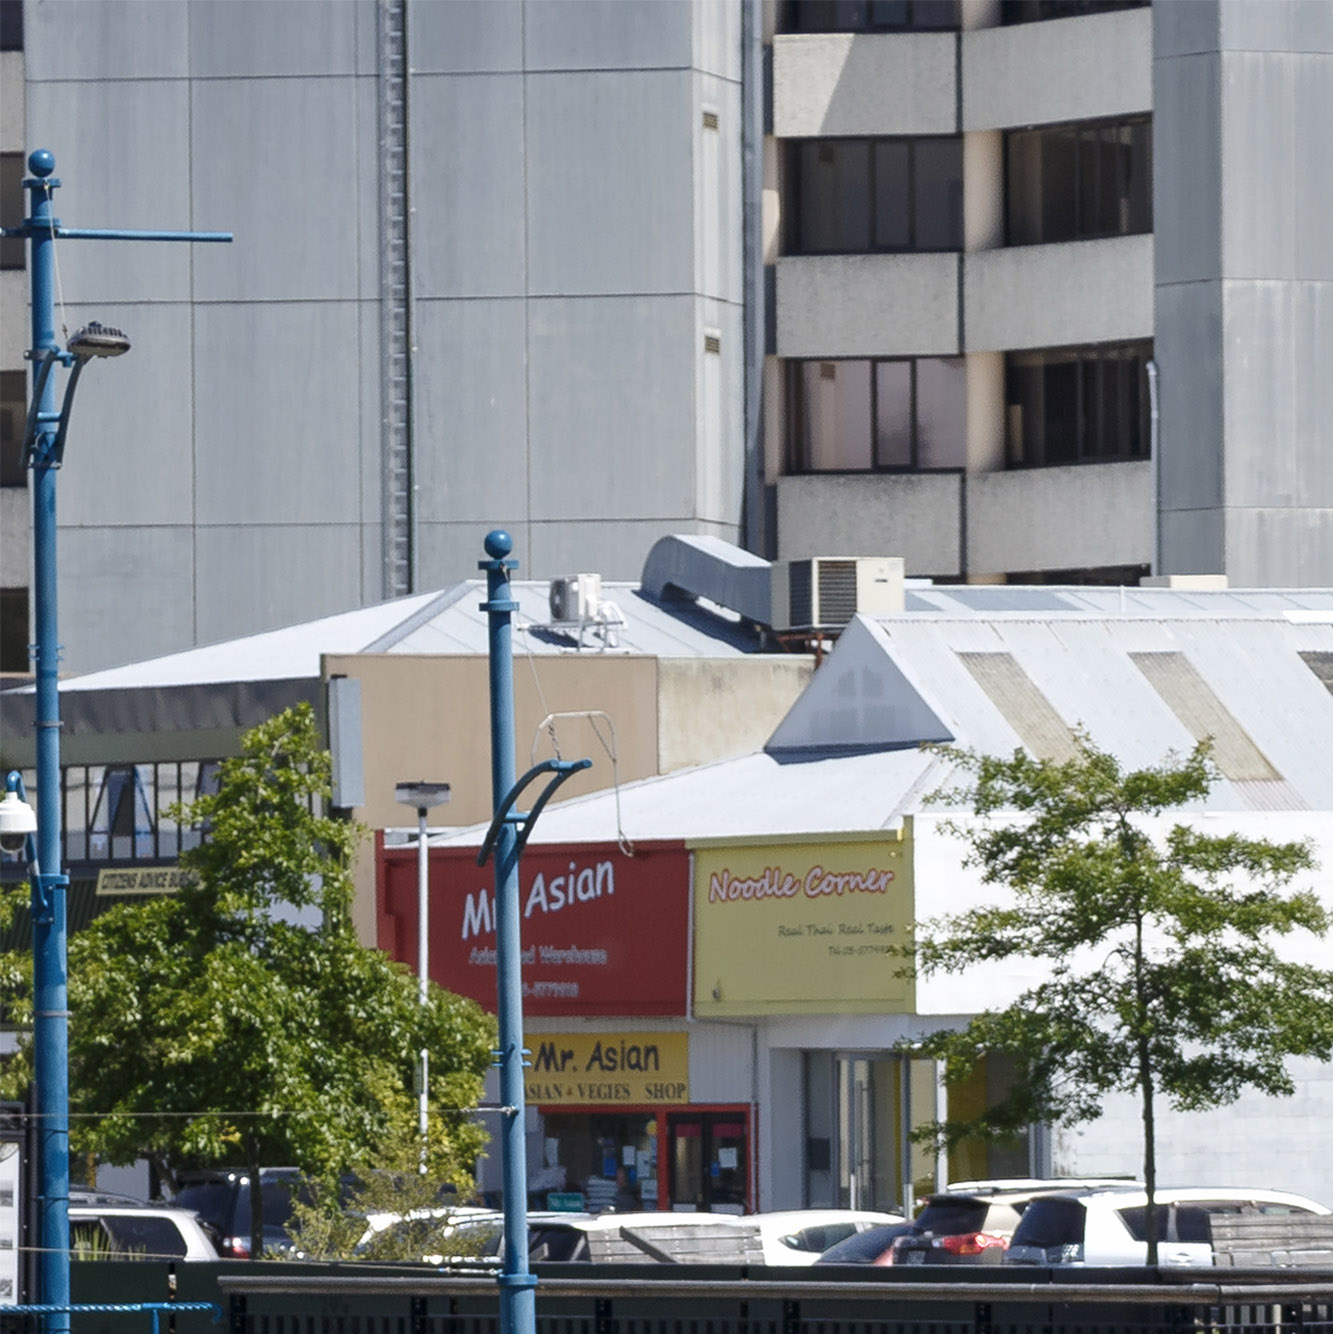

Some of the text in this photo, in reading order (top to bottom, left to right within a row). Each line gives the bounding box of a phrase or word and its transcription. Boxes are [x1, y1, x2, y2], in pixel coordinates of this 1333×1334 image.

[524, 860, 615, 919] Asian
[709, 865, 895, 904] Noodle Corner
[468, 944, 498, 966] Asia
[538, 943, 608, 966] Warehouse
[533, 1039, 661, 1073] Mr. Asian
[526, 1082, 687, 1100] SIAN VEGIES SHOP
